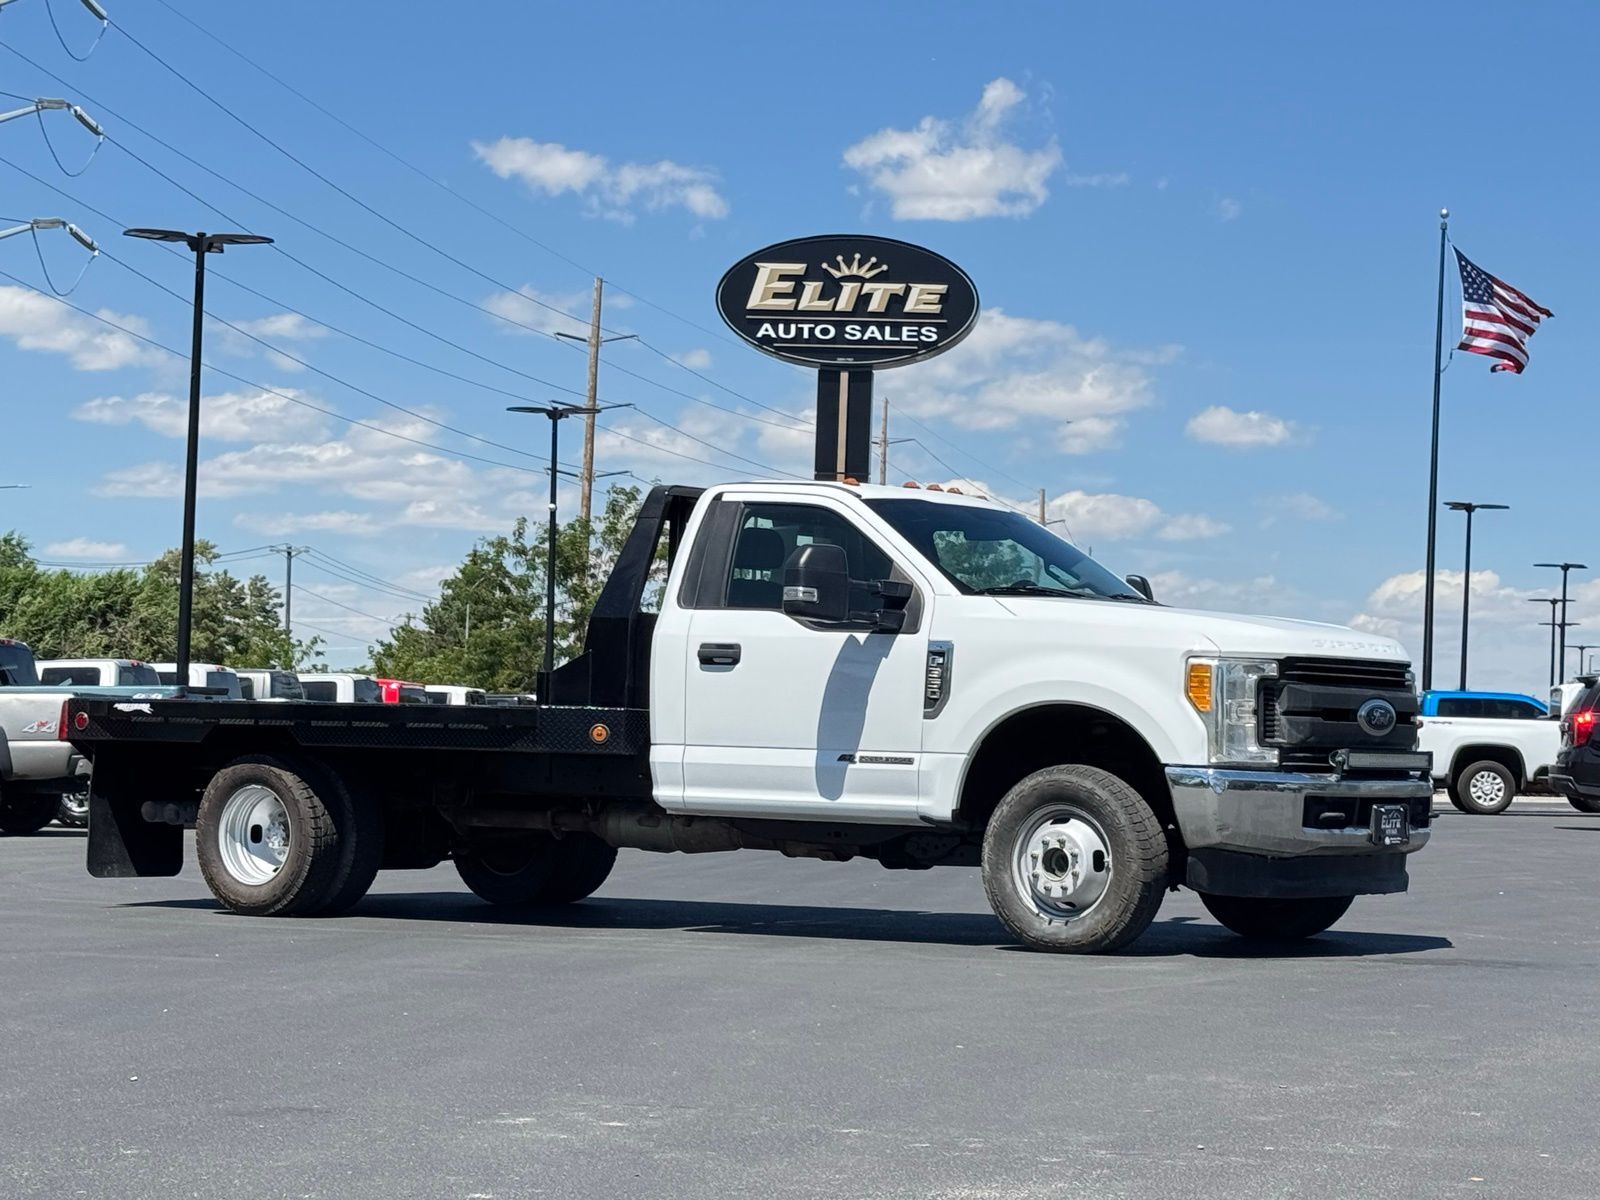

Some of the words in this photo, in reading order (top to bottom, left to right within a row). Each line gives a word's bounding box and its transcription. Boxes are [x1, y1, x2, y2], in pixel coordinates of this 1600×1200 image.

[746, 262, 949, 314] ELITE
[756, 323, 836, 340] AUTO
[844, 325, 938, 342] SALES
